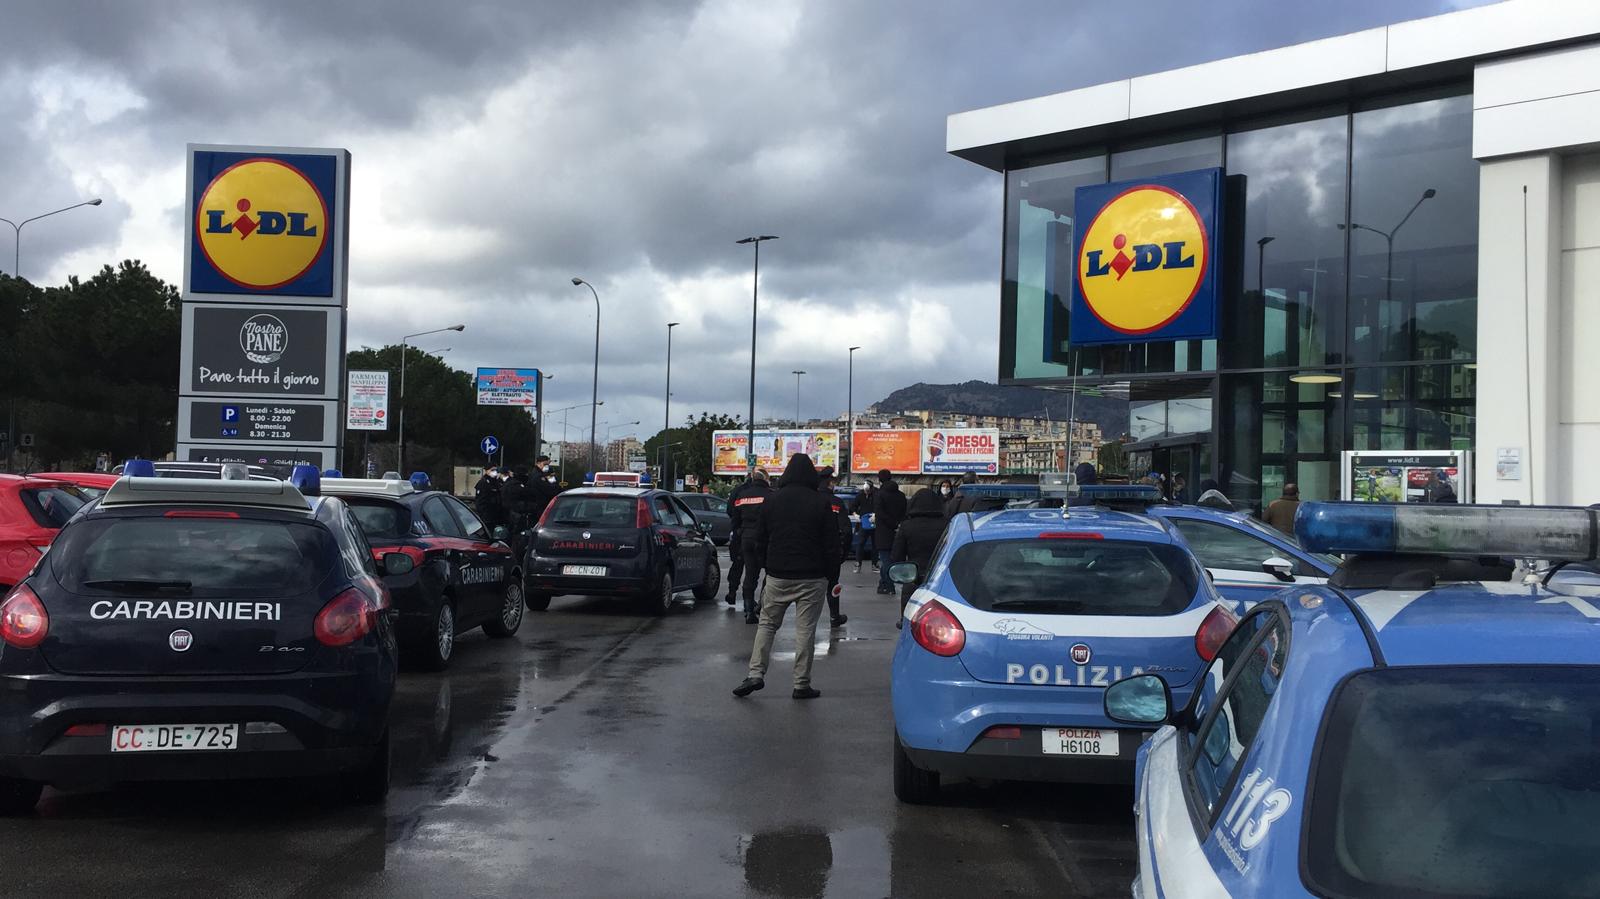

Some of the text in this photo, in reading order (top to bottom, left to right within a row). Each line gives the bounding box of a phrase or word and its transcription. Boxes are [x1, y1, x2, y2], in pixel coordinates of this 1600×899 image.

[245, 322, 282, 334] Nostro
[246, 333, 281, 352] PANE
[200, 366, 319, 390] Pane tutto il giorno
[273, 407, 296, 415] Sabato
[272, 415, 291, 423] 22.00
[271, 431, 291, 439] 21.30
[947, 435, 995, 447] PRESOL
[554, 541, 615, 549] CARABINIERI
[462, 566, 501, 584] CARABINIERI
[90, 601, 281, 621] CARABINIERI
[174, 635, 188, 646] FIAT
[1074, 650, 1087, 659] FIAT
[116, 727, 234, 749] CC DE 725
[1058, 729, 1101, 739] POLIZIA
[1061, 740, 1100, 753] H6108
[1223, 767, 1293, 851] 113
